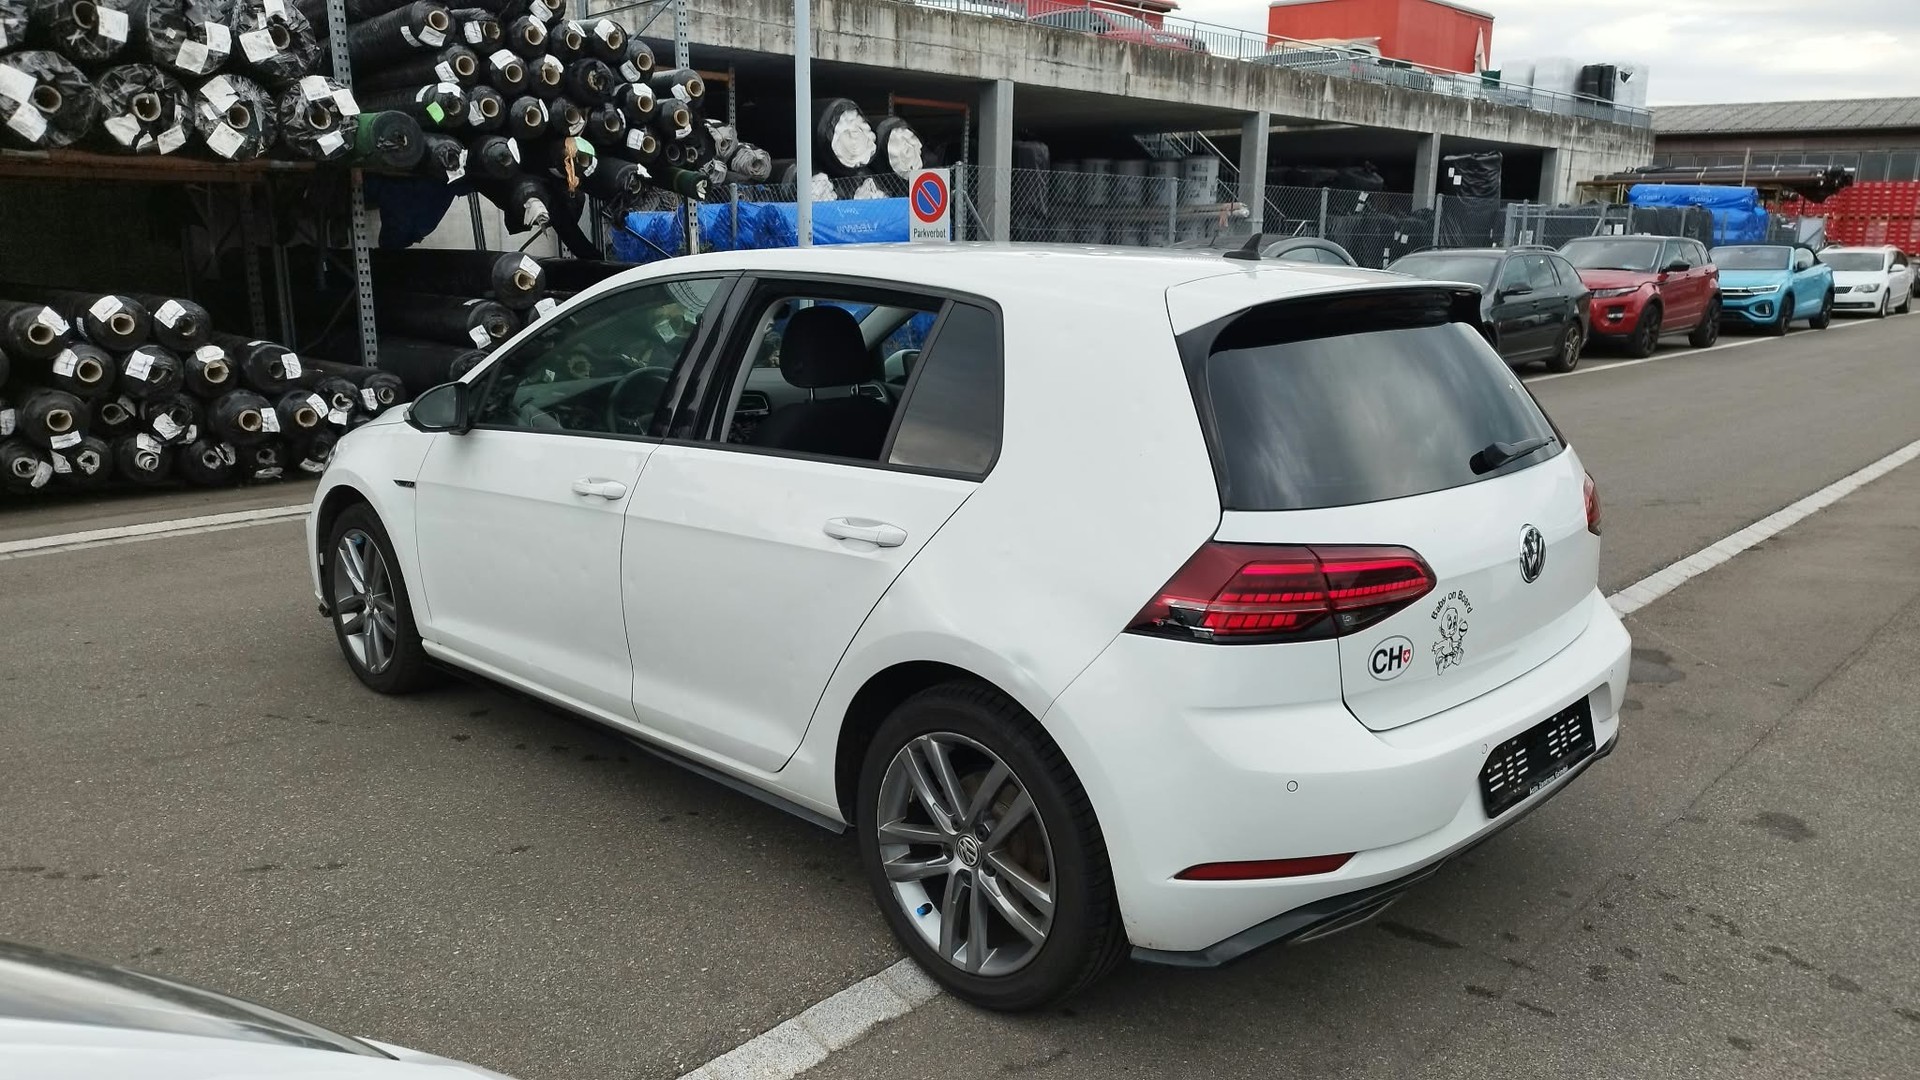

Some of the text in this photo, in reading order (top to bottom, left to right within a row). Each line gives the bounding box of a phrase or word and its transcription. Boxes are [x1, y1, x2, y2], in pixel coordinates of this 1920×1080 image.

[913, 227, 946, 238] Parkverbot
[1431, 589, 1473, 620] Baby on Board
[1372, 645, 1403, 674] CH
